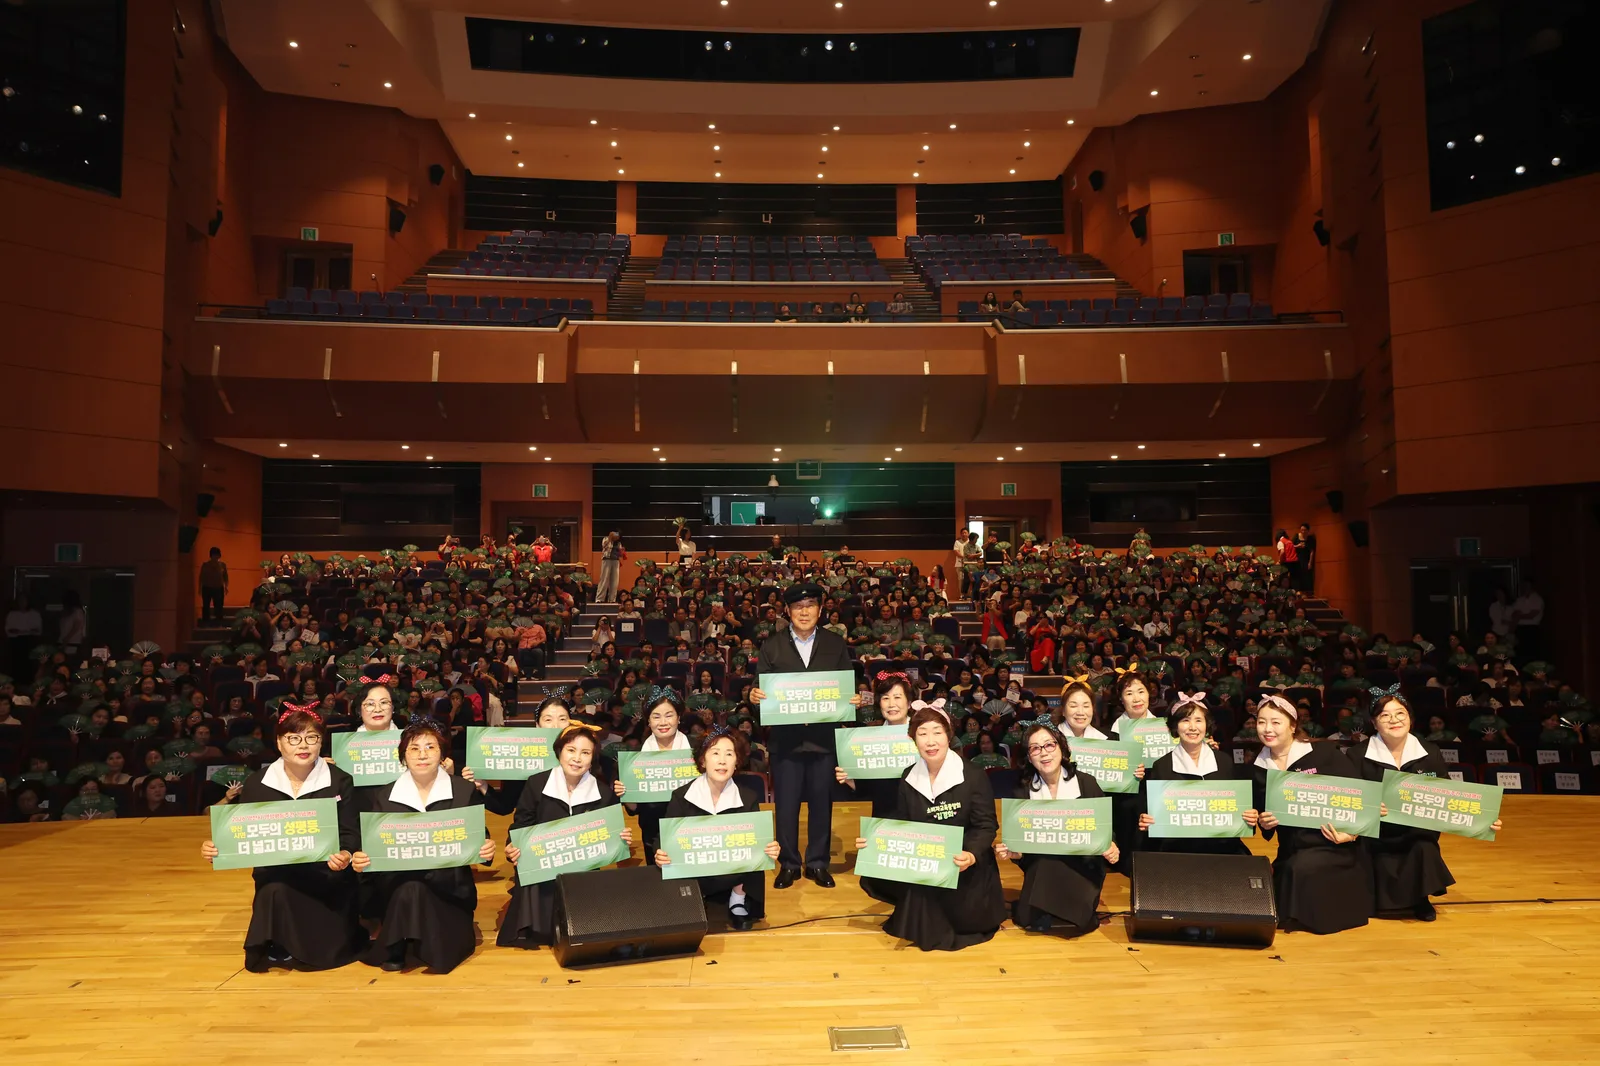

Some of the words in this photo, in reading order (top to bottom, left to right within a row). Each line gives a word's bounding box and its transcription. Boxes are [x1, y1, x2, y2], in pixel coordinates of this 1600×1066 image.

[546, 211, 556, 220] 다
[762, 214, 772, 223] 나
[974, 214, 985, 224] 가
[786, 689, 811, 700] 모두의
[779, 703, 788, 713] 더
[790, 702, 806, 713] 넓고
[809, 702, 817, 712] 더
[819, 701, 835, 711] 깊게
[1146, 734, 1170, 745] 모두의
[362, 748, 389, 760] 모두의
[492, 745, 518, 756] 모두의
[863, 744, 889, 755] 모두의
[485, 758, 494, 769] 더
[496, 758, 513, 769] 넓고
[515, 758, 524, 769] 더
[526, 759, 543, 770] 깊게
[857, 758, 866, 769] 더
[868, 757, 885, 769] 넓고
[887, 756, 896, 768] 더
[898, 756, 915, 767] 깊게
[1075, 754, 1101, 767] 모두의
[354, 764, 363, 775] 더
[366, 763, 384, 774] 넓고
[386, 762, 395, 773] 더
[646, 767, 671, 778] 모두의
[1096, 769, 1105, 780] 더
[1106, 770, 1123, 782] 깊게
[639, 781, 647, 792] 더
[650, 780, 667, 792] 넓고
[669, 780, 678, 790] 더
[1297, 790, 1327, 805] 모두의
[1412, 791, 1444, 807] 모두의
[1177, 799, 1205, 811] 모두의
[1287, 803, 1297, 815] 더
[1300, 804, 1320, 818] 넓고
[1322, 807, 1332, 819] 더
[1335, 809, 1356, 822] 깊게
[1401, 802, 1412, 814] 더
[1414, 805, 1436, 819] 넓고
[1437, 809, 1449, 821] 더
[1450, 812, 1473, 826] 깊게
[1033, 818, 1061, 829] 모두의
[1170, 814, 1179, 825] 더
[1182, 814, 1200, 825] 넓고
[1203, 814, 1211, 825] 더
[1214, 814, 1232, 825] 깊게
[247, 823, 280, 837] 모두의
[395, 831, 428, 844] 모두의
[692, 835, 722, 848] 모두의
[1024, 831, 1033, 842] 더
[1036, 831, 1056, 843] 넓고
[1058, 832, 1068, 843] 더
[1071, 832, 1090, 844] 깊게
[238, 841, 249, 854] 더
[252, 839, 275, 853] 넓고
[278, 838, 288, 851] 더
[291, 836, 313, 850] 깊게
[387, 847, 398, 859] 더
[401, 846, 422, 858] 넓고
[426, 845, 436, 856] 더
[439, 843, 460, 855] 깊게
[545, 836, 576, 853] 모두의
[887, 839, 914, 854] 모두의
[539, 856, 551, 870] 더
[552, 851, 573, 866] 넓고
[574, 848, 584, 860] 더
[586, 842, 606, 857] 깊게
[684, 852, 694, 864] 더
[697, 850, 717, 863] 넓고
[719, 849, 729, 861] 더
[731, 848, 751, 860] 깊게
[877, 853, 887, 866] 더
[888, 854, 907, 869] 넓고
[908, 857, 918, 870] 더
[919, 858, 938, 873] 깊게
